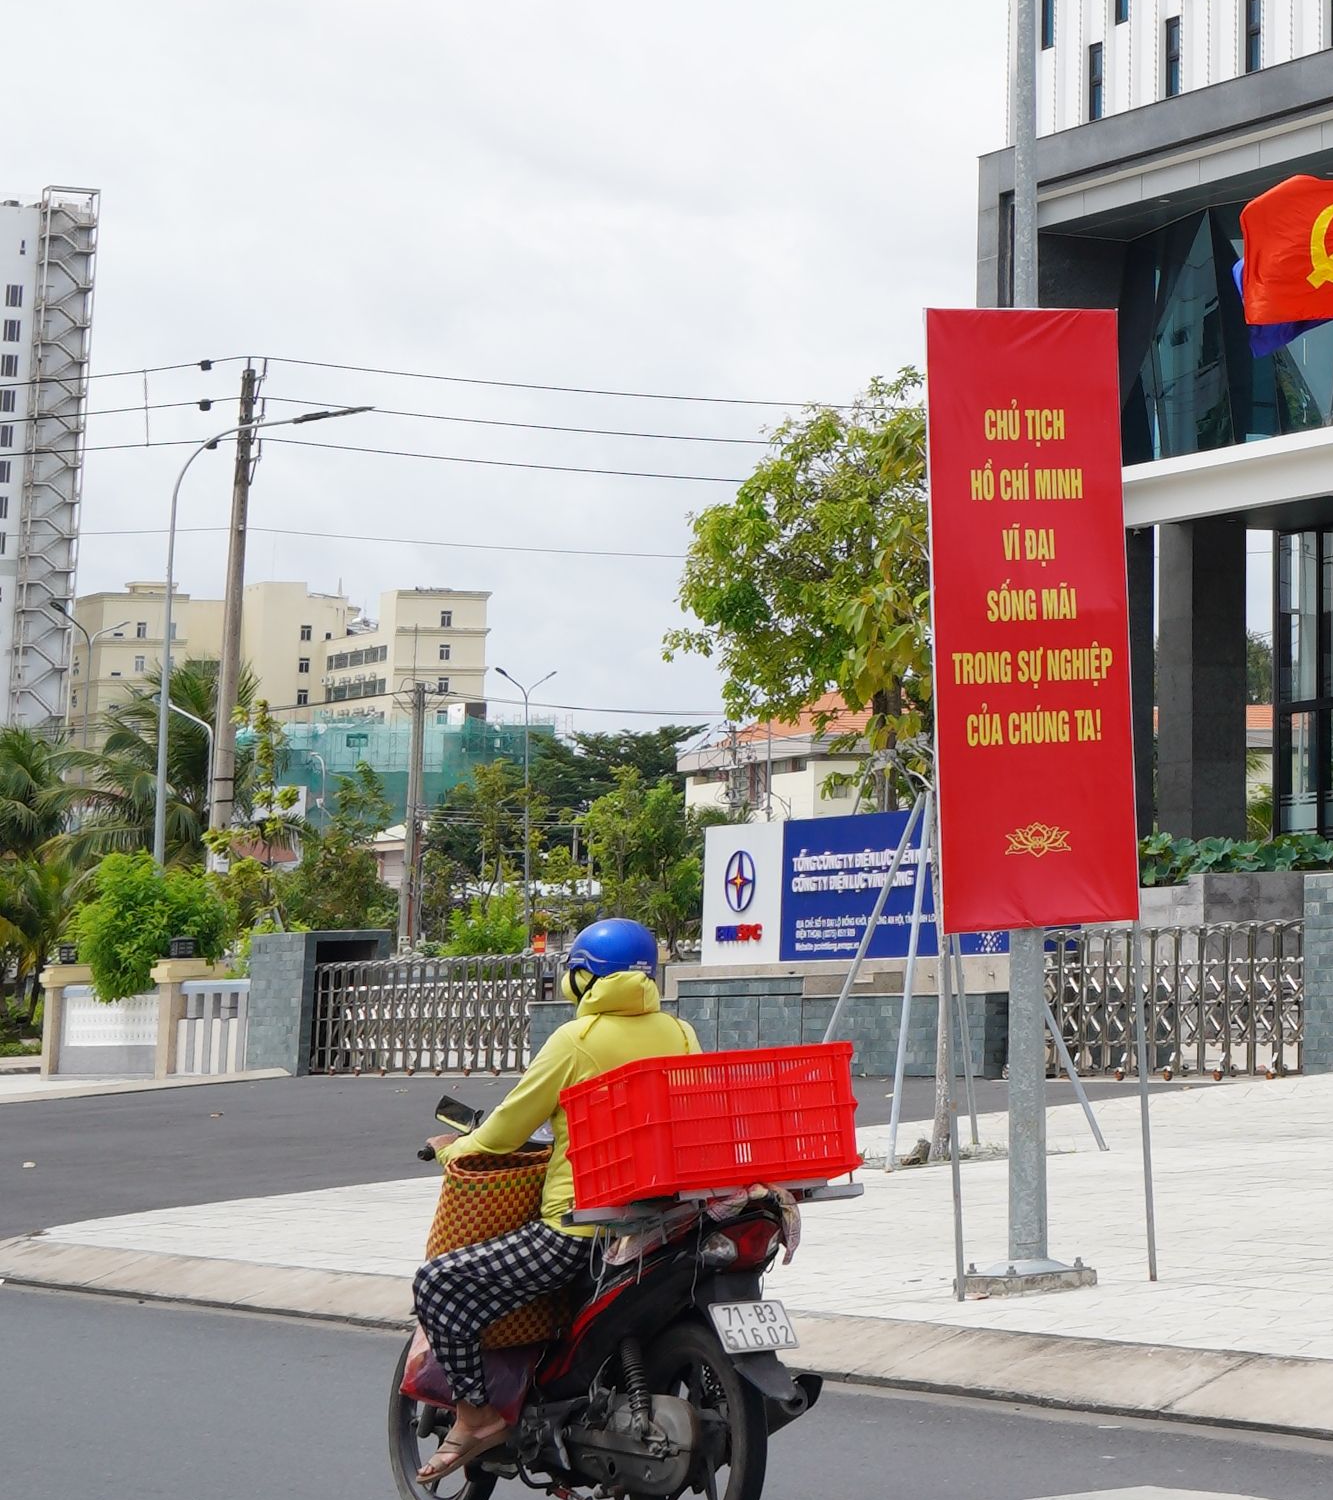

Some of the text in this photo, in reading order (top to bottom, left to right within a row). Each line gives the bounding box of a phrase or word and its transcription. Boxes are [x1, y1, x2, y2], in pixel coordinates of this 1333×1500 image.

[984, 399, 1065, 447] CHỦ TỊCH
[970, 459, 1083, 500] HỒ CHÍ MINH
[1002, 523, 1056, 567] VĨ ĐẠI
[987, 579, 1077, 622] SỐNG MÃI
[952, 641, 1113, 689] TRONG SỰ NGHIỆP
[967, 702, 1102, 747] CỦA CHÚNG TA!
[722, 1304, 777, 1327] 71-B3
